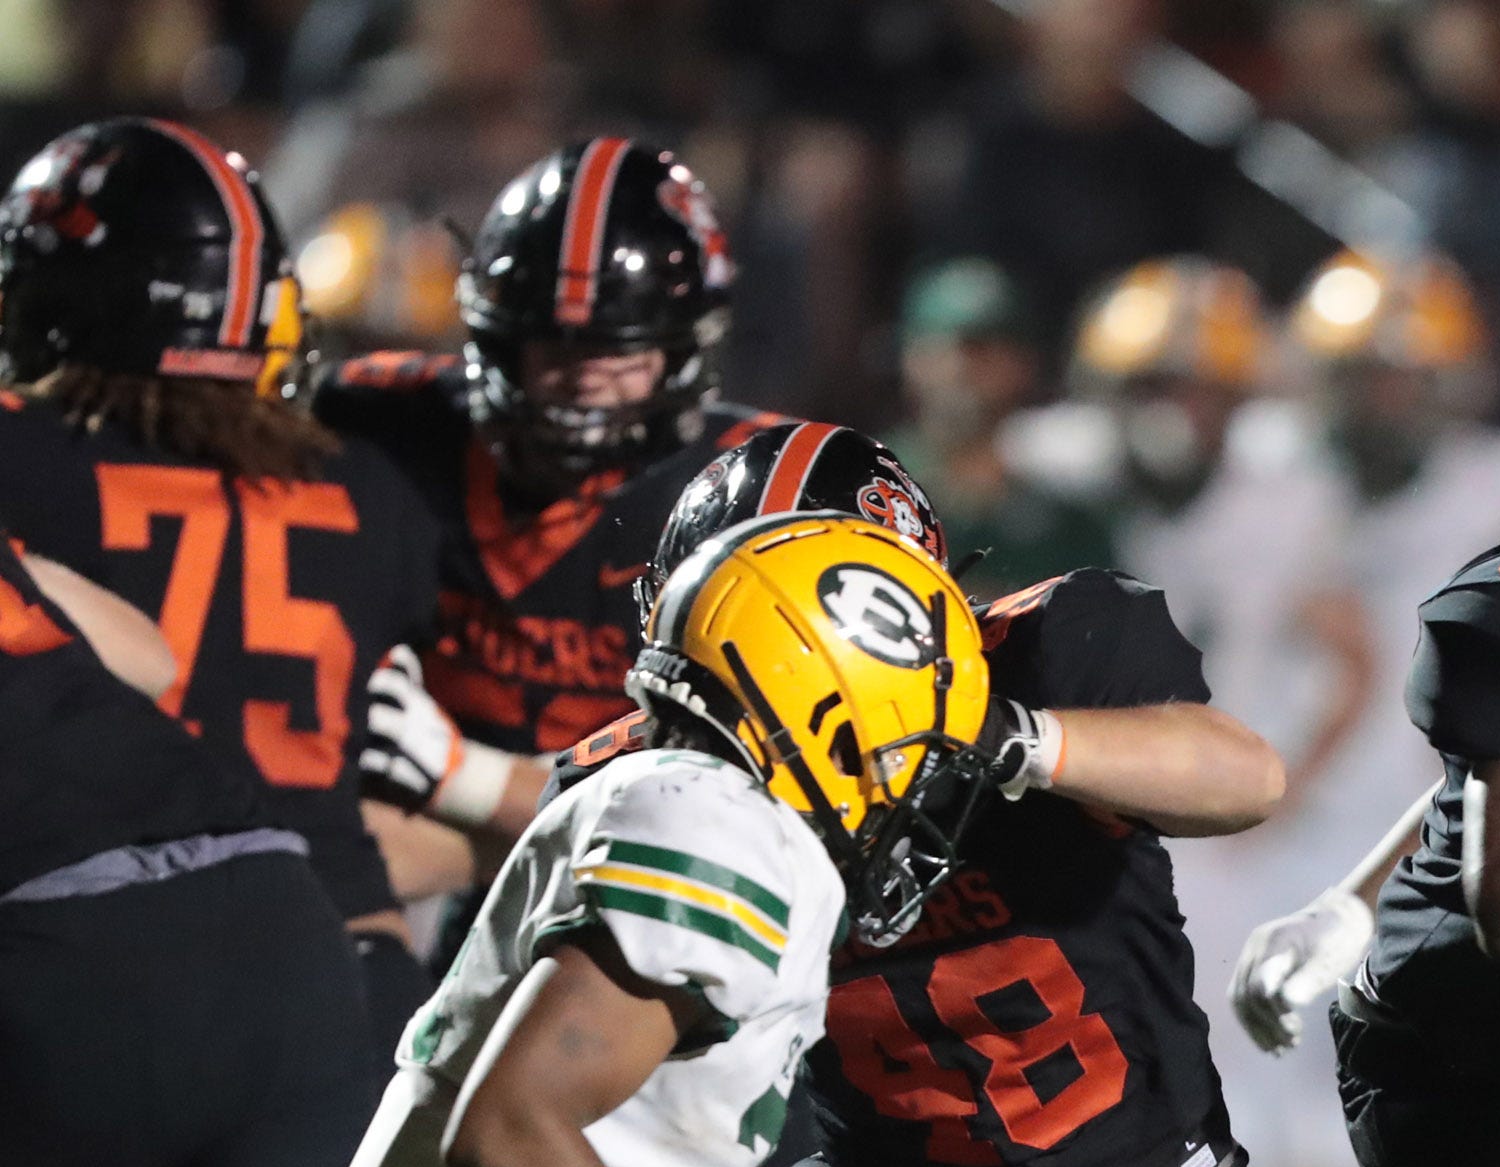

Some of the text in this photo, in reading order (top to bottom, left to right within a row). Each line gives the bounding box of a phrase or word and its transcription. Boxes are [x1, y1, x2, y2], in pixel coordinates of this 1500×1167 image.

[94, 462, 360, 789] 75
[822, 568, 933, 662] E
[829, 935, 1129, 1167] 48
